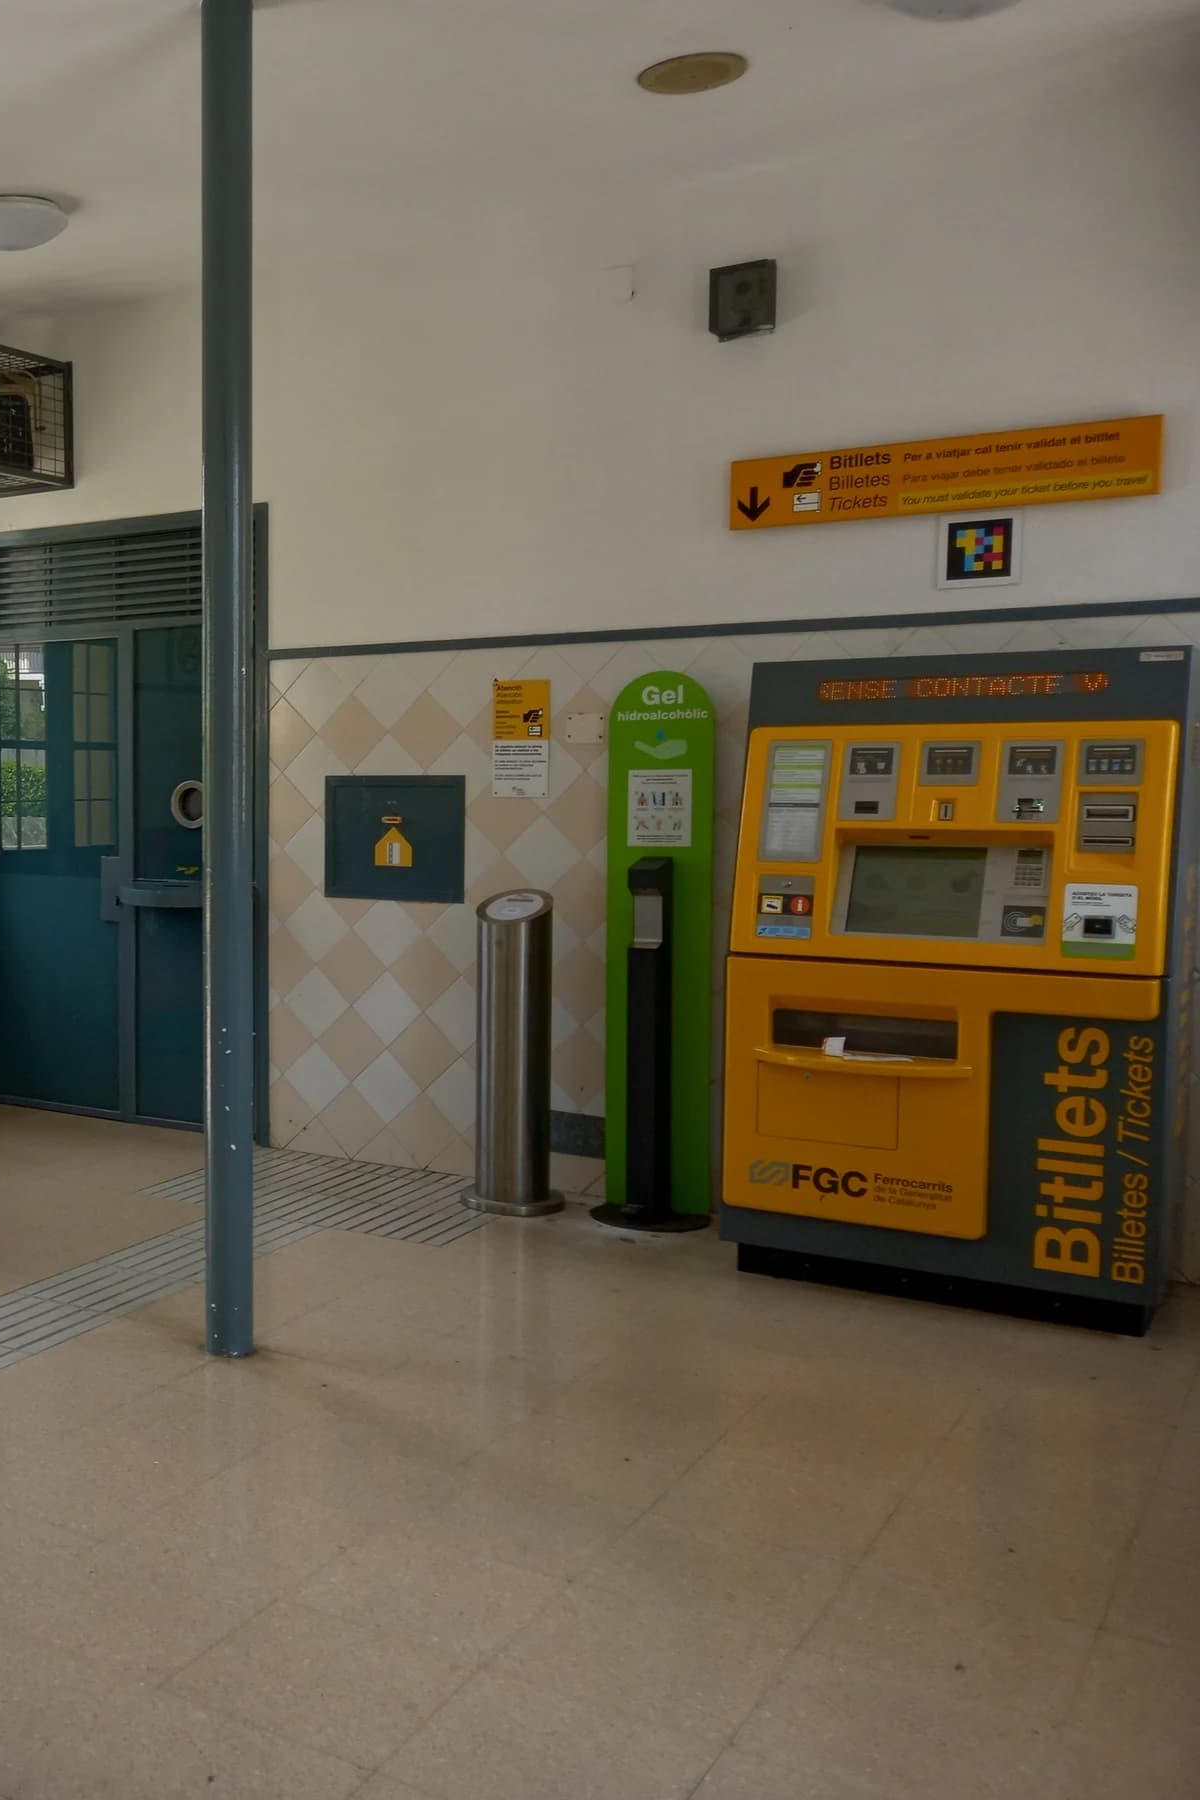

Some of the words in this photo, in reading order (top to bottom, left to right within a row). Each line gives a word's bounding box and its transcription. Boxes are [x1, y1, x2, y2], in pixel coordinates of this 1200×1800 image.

[903, 452, 923, 462] Per
[926, 452, 933, 460] a
[935, 448, 972, 459] viatjar
[974, 444, 992, 455] cal
[995, 441, 1022, 453] tenir
[1026, 437, 1067, 449] validat
[1070, 434, 1081, 445] el
[1084, 431, 1120, 443] bitllet
[830, 452, 891, 469] Bitllets
[830, 474, 890, 490] Billetes
[903, 473, 928, 483] Para
[930, 471, 960, 482] viajar
[962, 467, 991, 478] debe
[993, 464, 1022, 474] tener
[829, 494, 888, 511] Tickets
[902, 495, 921, 505] You
[992, 487, 1018, 500] your
[1053, 479, 1089, 492] before
[1092, 479, 1113, 490] you
[641, 683, 685, 706] Gel
[914, 673, 1064, 698] CONTACTE
[1115, 1034, 1155, 1143] Tickets
[1032, 1025, 1111, 1279] Bitllets
[791, 1163, 868, 1198] FGC
[873, 1173, 953, 1194] Ferrocarrils
[1111, 1171, 1149, 1285] Billetes
